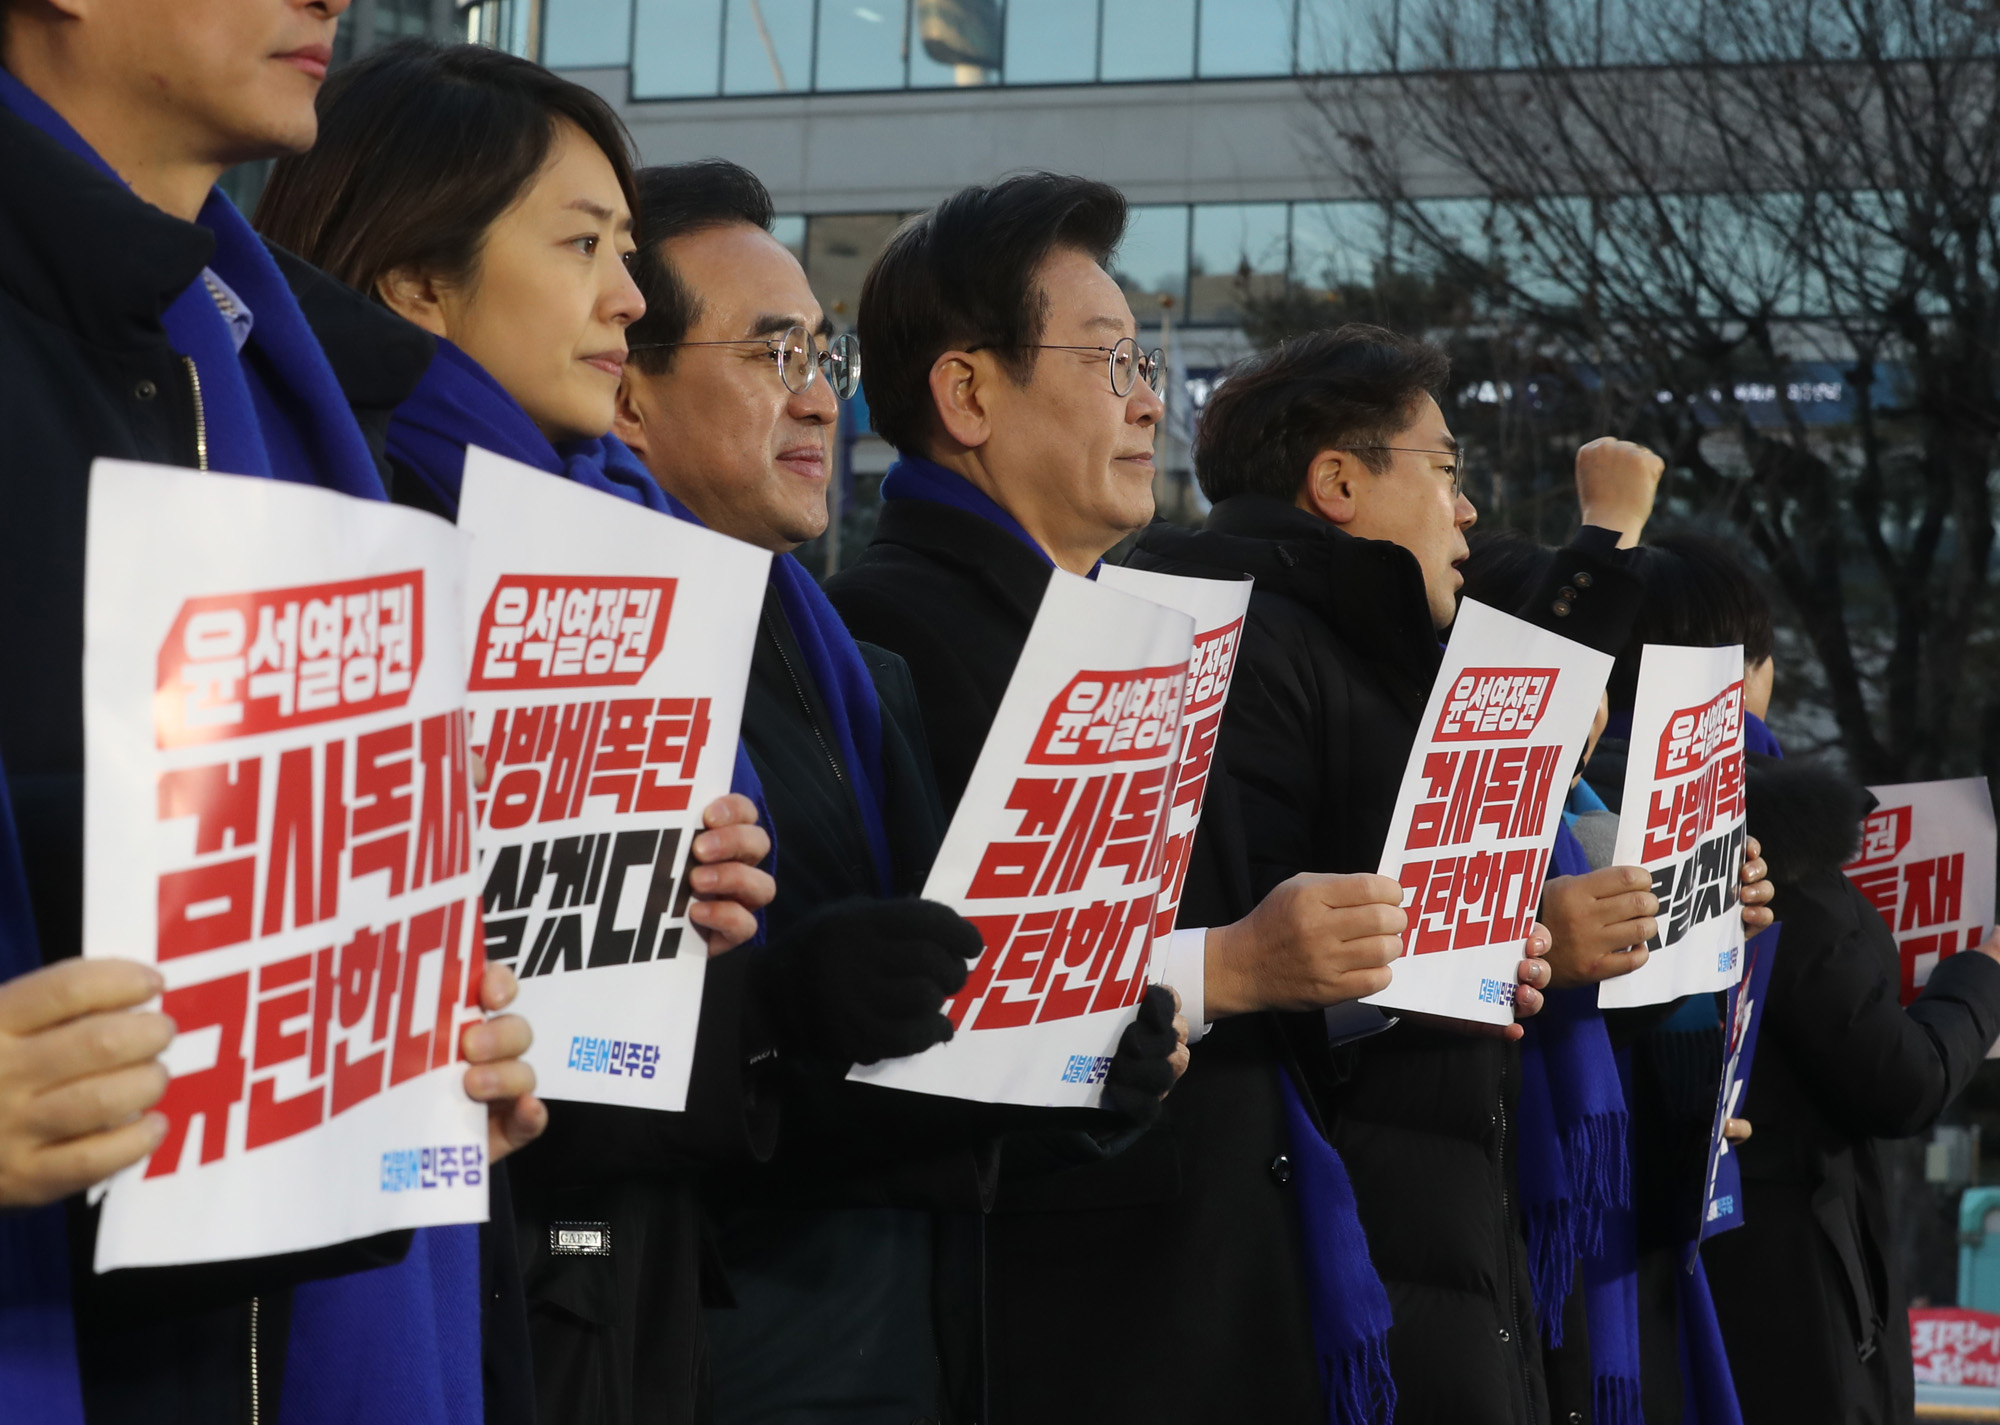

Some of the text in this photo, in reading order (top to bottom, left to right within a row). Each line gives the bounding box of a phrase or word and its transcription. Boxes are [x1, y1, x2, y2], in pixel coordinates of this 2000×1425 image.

[181, 584, 415, 729] 윤석열정권
[483, 585, 662, 680] 윤석열정권
[1186, 626, 1239, 706] 열정권
[1046, 678, 1178, 756] 윤석열정권
[1440, 675, 1550, 734] 윤석열정권
[1665, 686, 1742, 771] 윤석열정권
[156, 706, 470, 962] 검사독재
[1404, 744, 1563, 850] 검사독재
[475, 827, 707, 980] 살겠다!
[1398, 847, 1550, 959] 규탄한다!
[1848, 852, 1965, 933] 독재
[142, 895, 487, 1180] 규탄한다!
[567, 1036, 661, 1079] 더불어민주당
[1061, 1055, 1113, 1085] 더불어민주
[381, 1145, 483, 1192] 더불어민주당
[560, 1232, 600, 1244] GAFFY
